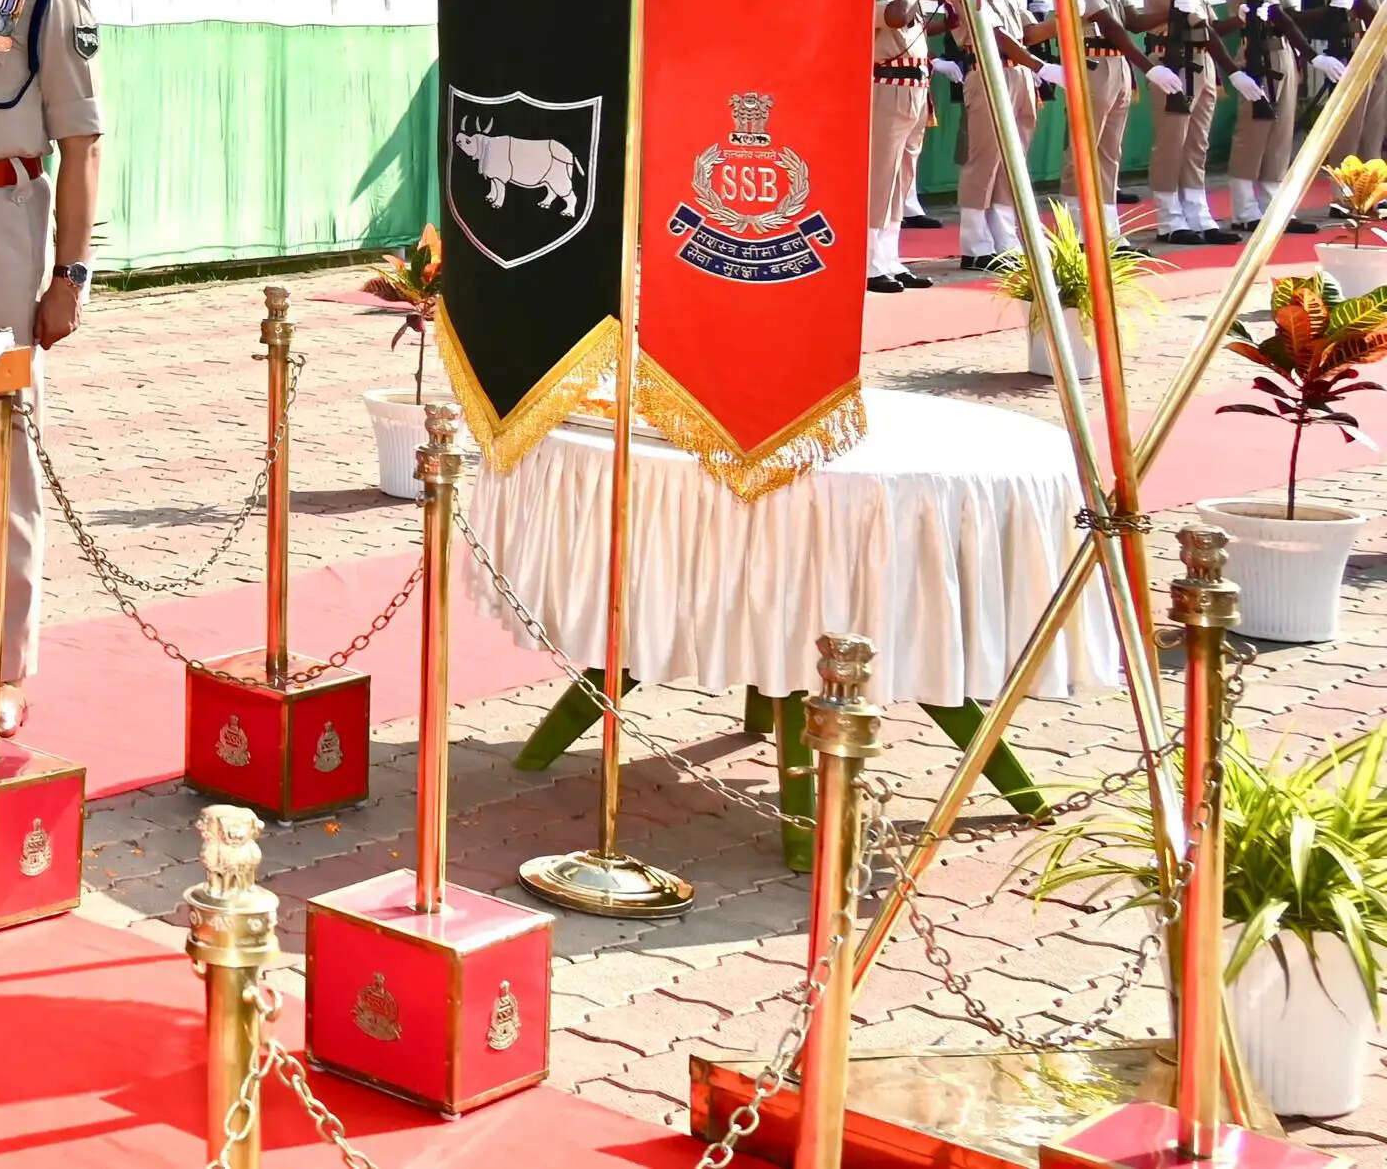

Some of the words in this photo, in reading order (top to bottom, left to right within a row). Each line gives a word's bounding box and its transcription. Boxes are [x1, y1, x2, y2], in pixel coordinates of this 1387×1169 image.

[722, 164, 777, 202] SSB
[695, 231, 738, 255] सशस्त्र
[741, 244, 777, 259] सीमा
[780, 236, 804, 251] बल
[686, 246, 712, 267] सेवा
[723, 261, 758, 278] सुरक्षा
[770, 253, 813, 274] बन्धुत्व
